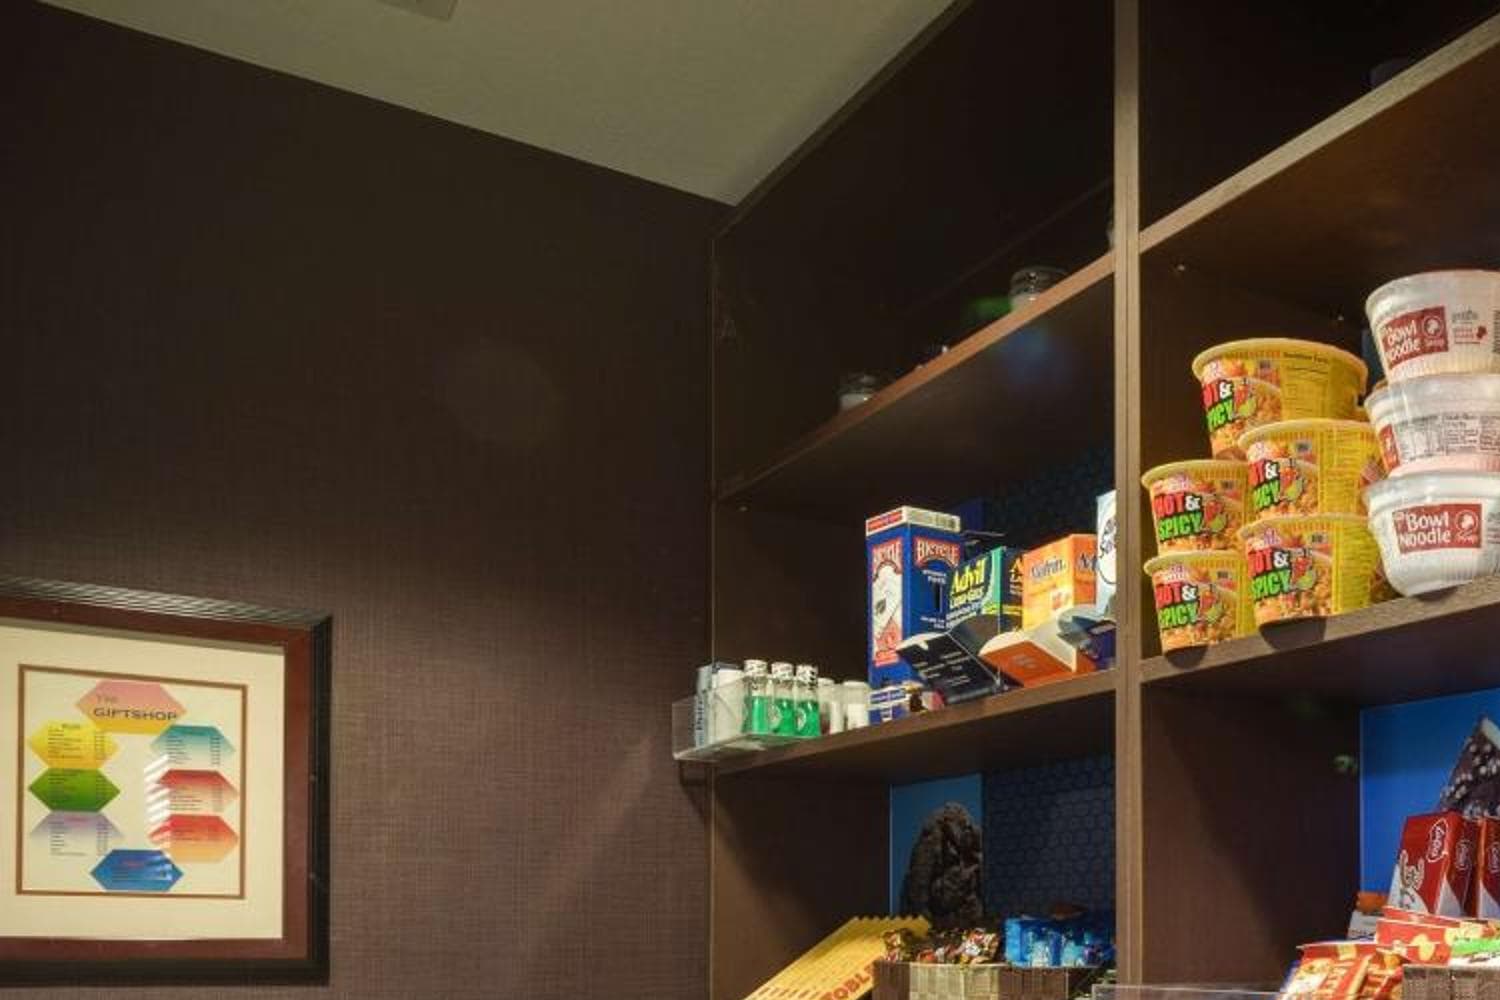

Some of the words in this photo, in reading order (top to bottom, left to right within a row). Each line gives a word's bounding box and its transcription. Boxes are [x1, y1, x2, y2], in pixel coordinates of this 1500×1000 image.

[1219, 380, 1233, 399] &
[1265, 461, 1280, 480] &
[1154, 492, 1185, 518] HOT
[1185, 494, 1202, 511] &
[1158, 511, 1203, 542] SPICY
[1407, 511, 1450, 531] Bowl
[1400, 528, 1451, 547] Noodle
[916, 540, 960, 563] BICYCLE
[1273, 550, 1290, 569] &
[951, 557, 987, 594] Advil
[1154, 582, 1182, 609] HOT
[1182, 584, 1198, 602] &
[1158, 601, 1198, 630] SPICY
[93, 707, 178, 721] GIFTSHOP
